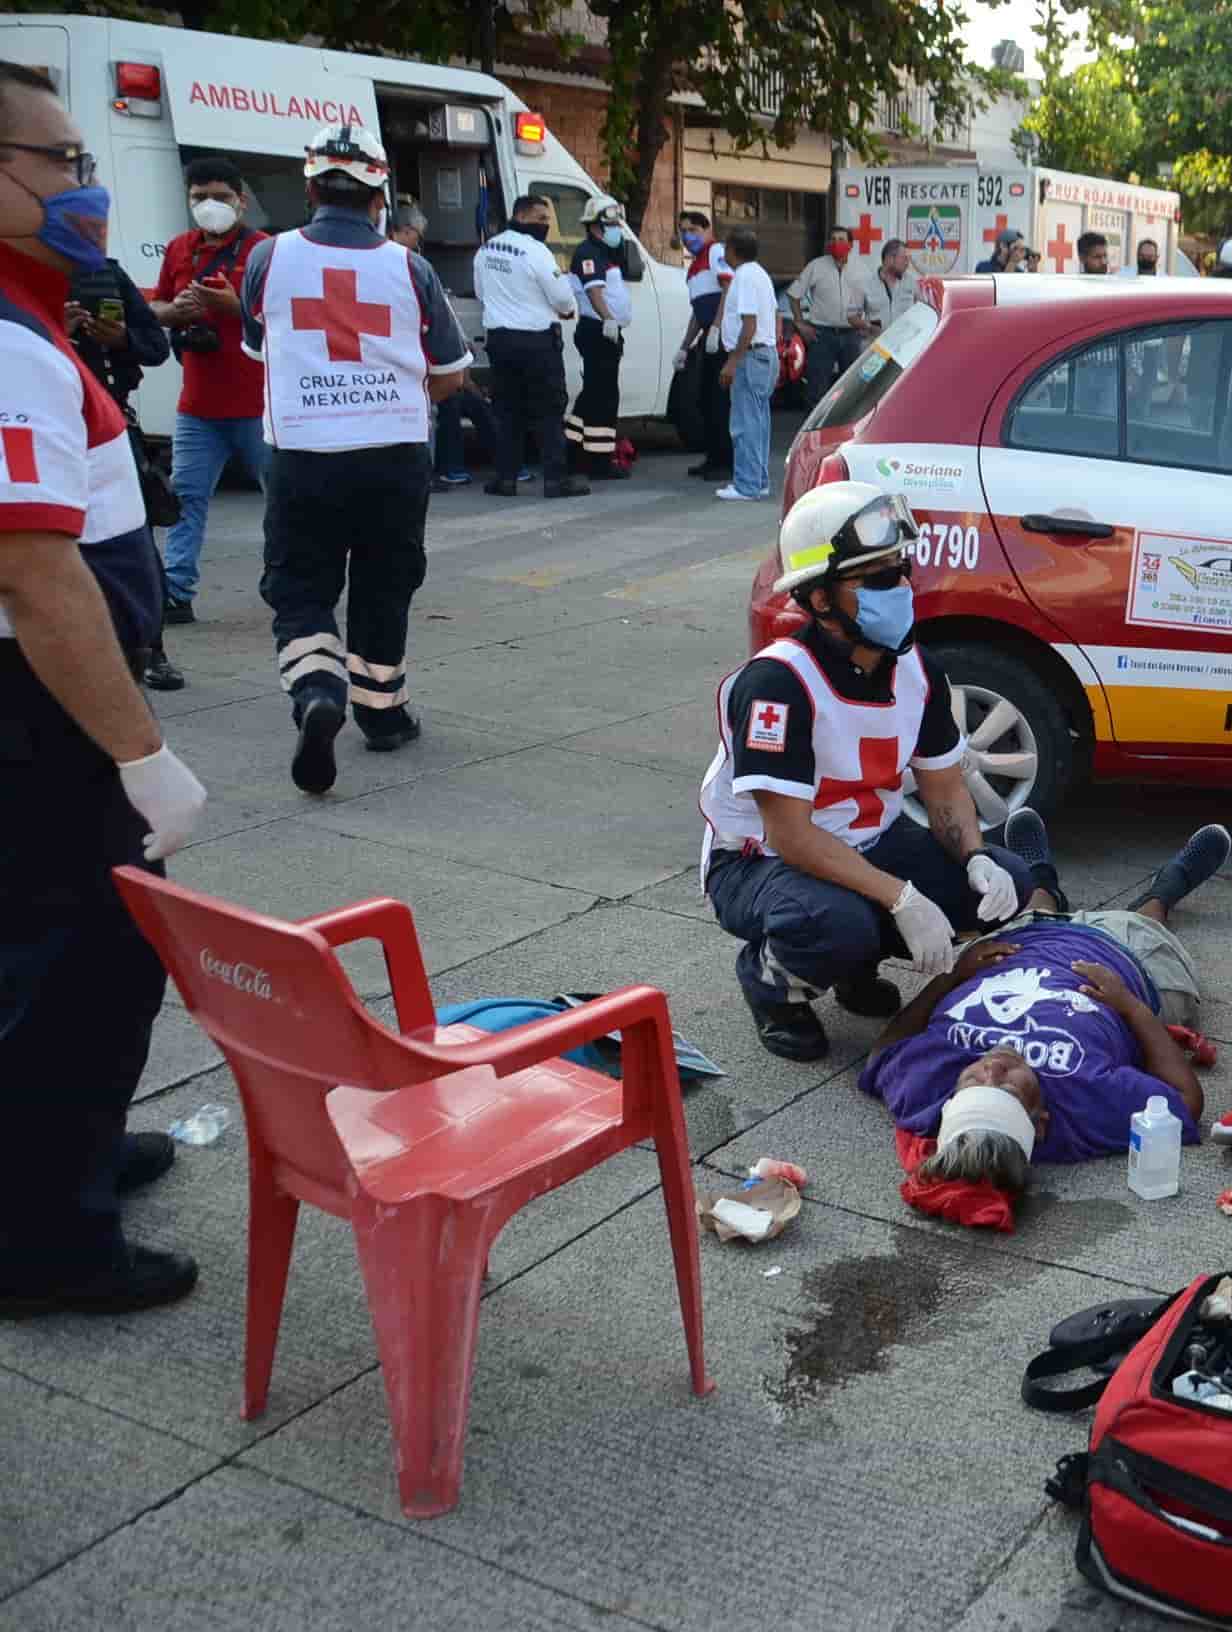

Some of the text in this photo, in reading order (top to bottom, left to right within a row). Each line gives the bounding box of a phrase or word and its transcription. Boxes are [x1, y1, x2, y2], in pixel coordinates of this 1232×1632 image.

[189, 81, 364, 128] AMBULANCIA
[865, 175, 891, 206] VER
[899, 183, 969, 200] RESCATE
[977, 175, 1003, 207] 592
[1083, 187, 1113, 205] ROJA
[300, 372, 397, 390] CRUZ ROJA
[302, 389, 401, 408] MEXICANA
[904, 463, 962, 477] Soriana
[901, 522, 979, 569] -6790
